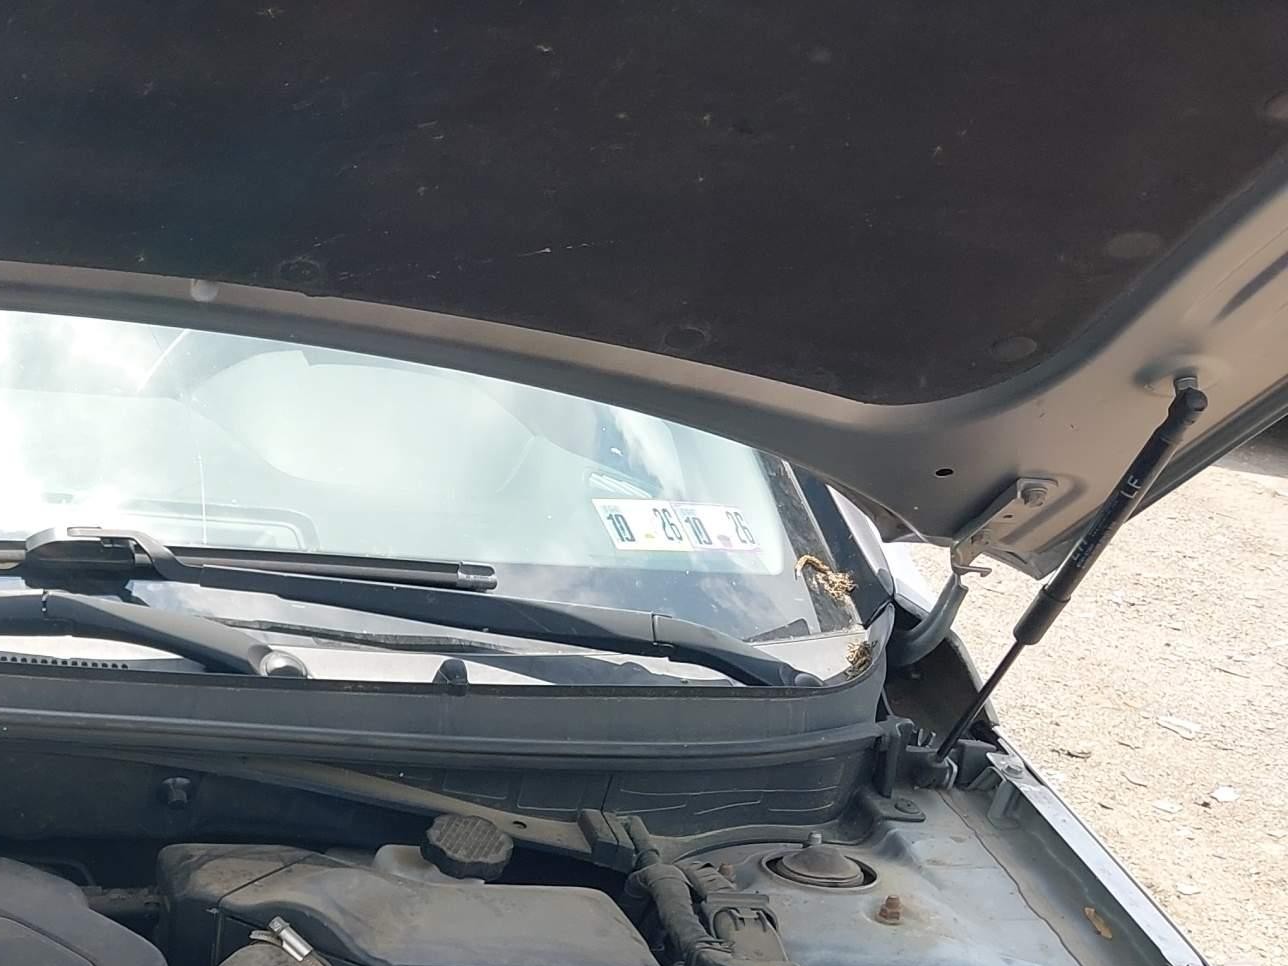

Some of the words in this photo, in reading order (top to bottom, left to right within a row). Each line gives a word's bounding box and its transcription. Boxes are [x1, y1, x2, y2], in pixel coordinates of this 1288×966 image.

[606, 513, 636, 542] 10
[652, 508, 683, 541] 26
[684, 516, 713, 545] 10
[726, 511, 756, 544] 26
